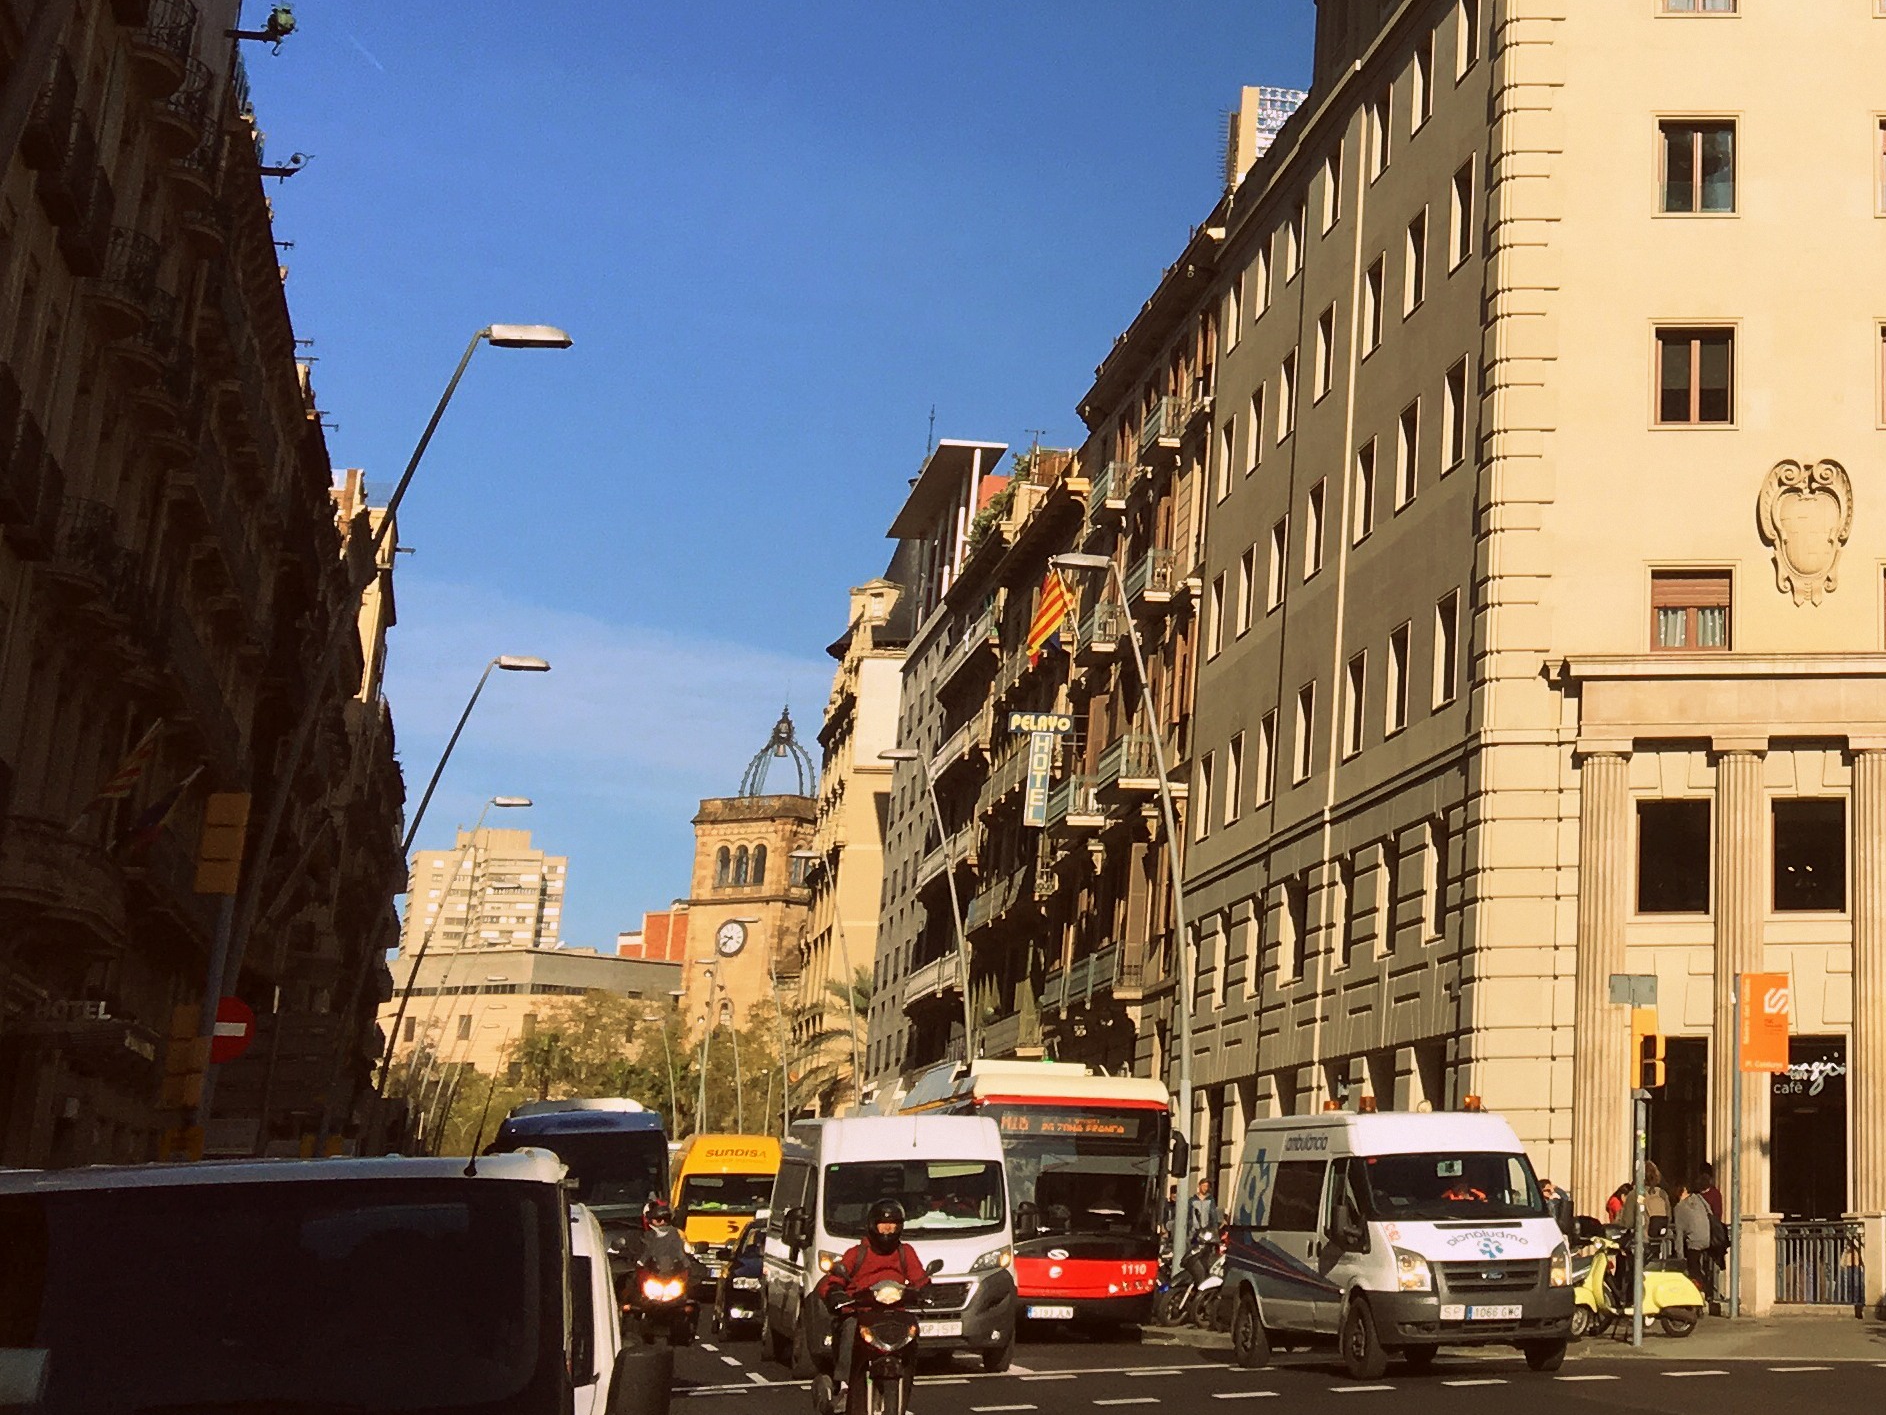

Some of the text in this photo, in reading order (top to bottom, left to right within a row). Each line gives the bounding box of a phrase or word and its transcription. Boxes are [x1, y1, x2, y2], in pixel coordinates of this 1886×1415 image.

[1011, 713, 1071, 732] PELAYO
[1028, 736, 1050, 824] HOTEL
[1121, 1263, 1147, 1275] 1110
